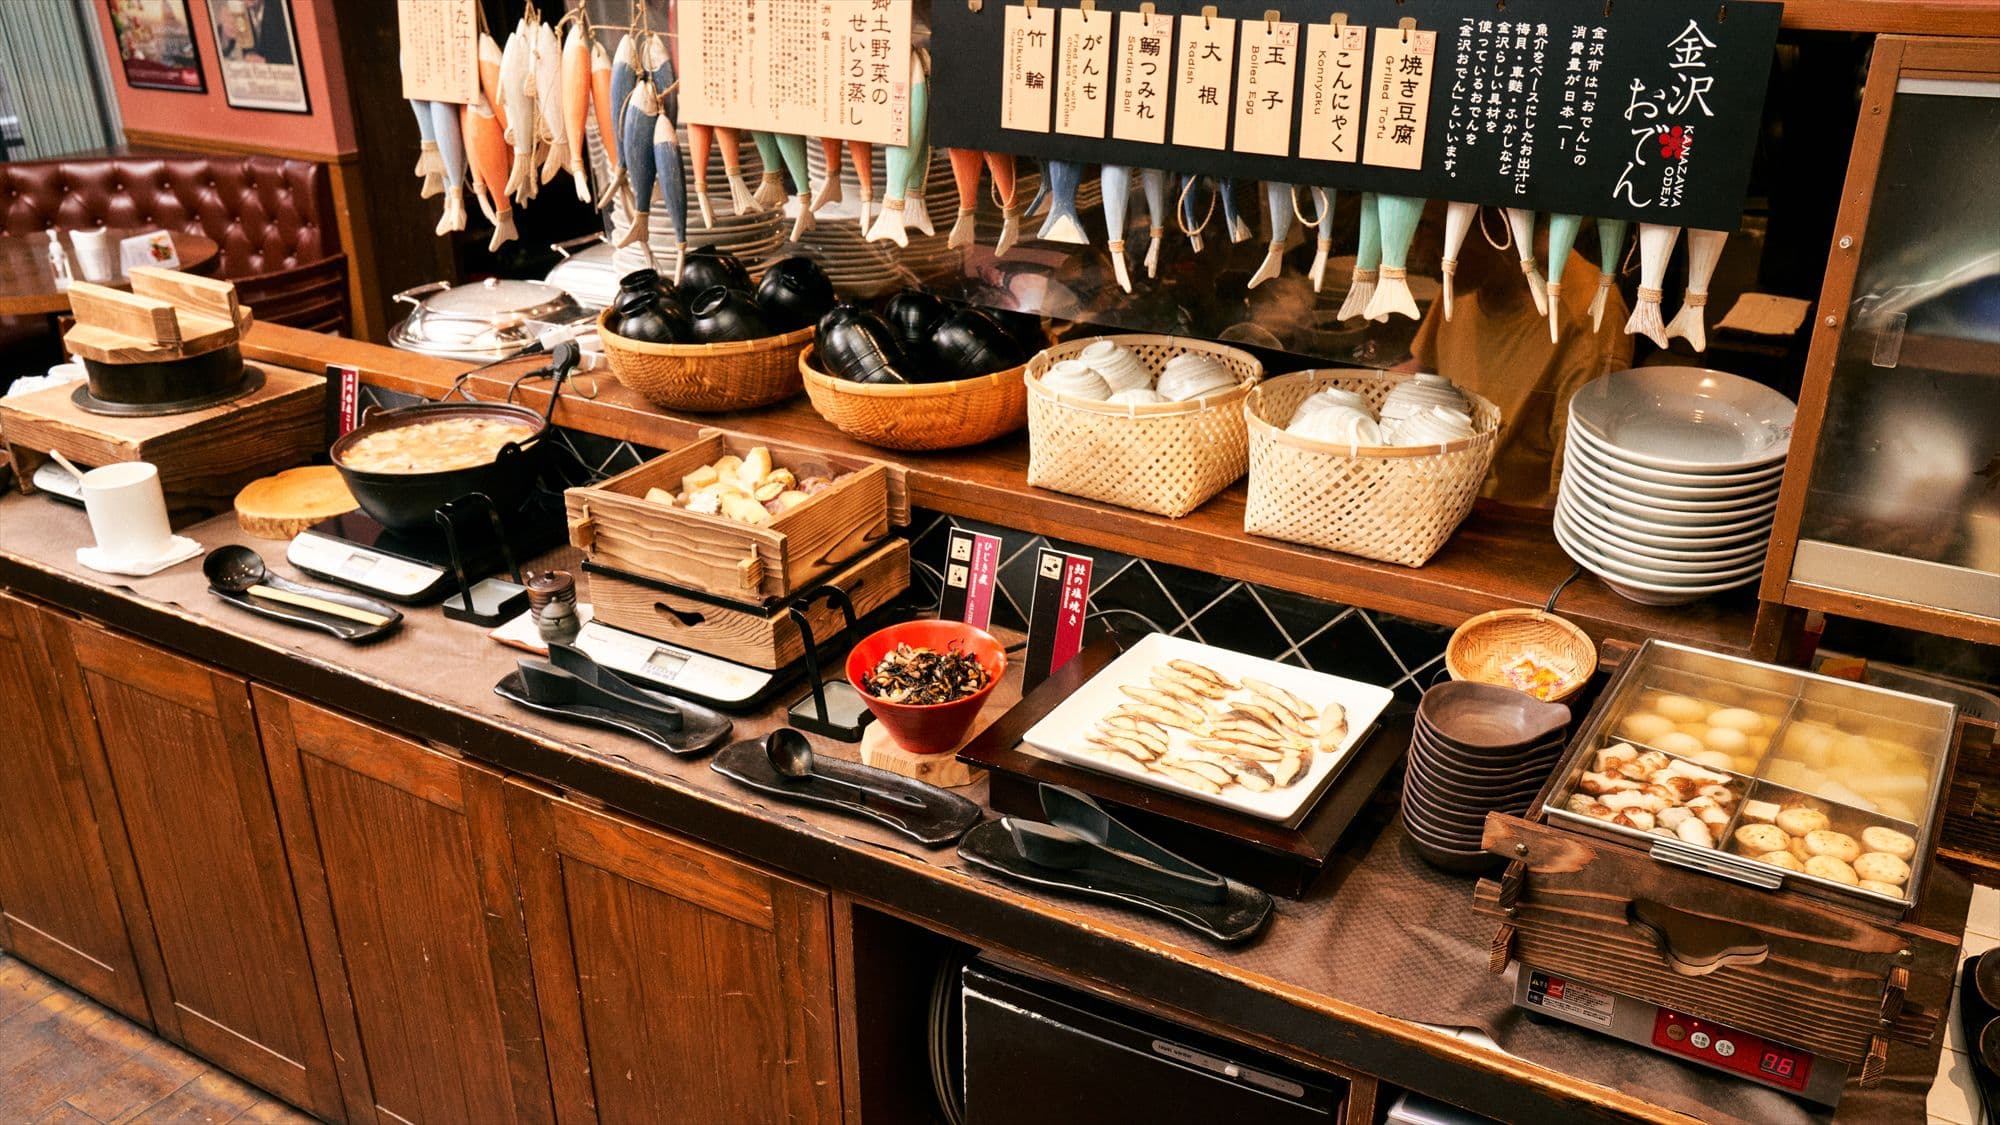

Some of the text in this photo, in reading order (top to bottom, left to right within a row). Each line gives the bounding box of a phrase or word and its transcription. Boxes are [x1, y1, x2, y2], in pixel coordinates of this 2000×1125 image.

[848, 13, 867, 125] せいろ蒸し
[1025, 29, 1047, 89] 竹輪
[1082, 34, 1103, 100] がんも
[1124, 35, 1136, 112] Sardine Ball
[1136, 36, 1160, 119] 鰯つみれ
[1186, 41, 1197, 84] Radish
[1198, 42, 1222, 106] 大根
[1246, 45, 1260, 115] Boiled Egg
[1262, 46, 1287, 110] 玉子
[1314, 50, 1327, 115] Konnyaku
[1376, 55, 1395, 139] Grilled Tofu
[1391, 54, 1423, 146] 焼き豆腐
[1444, 17, 1474, 178] 「金沢おでん」といいます。
[1465, 20, 1493, 145] 使っているおでんを
[1485, 21, 1513, 133] 金沢らしい具材を
[1557, 25, 1587, 150] 消費量が日本一！
[1574, 26, 1607, 166] 金沢市は「おでん」の
[1667, 19, 1717, 117] 金沢
[1331, 51, 1353, 153] こんにゃく
[1514, 23, 1549, 194] 魚介をベースにしたお出汁に
[1612, 78, 1670, 208] おでん
[1658, 166, 1674, 207] ODEN
[1670, 125, 1695, 208] KANAZAWA
